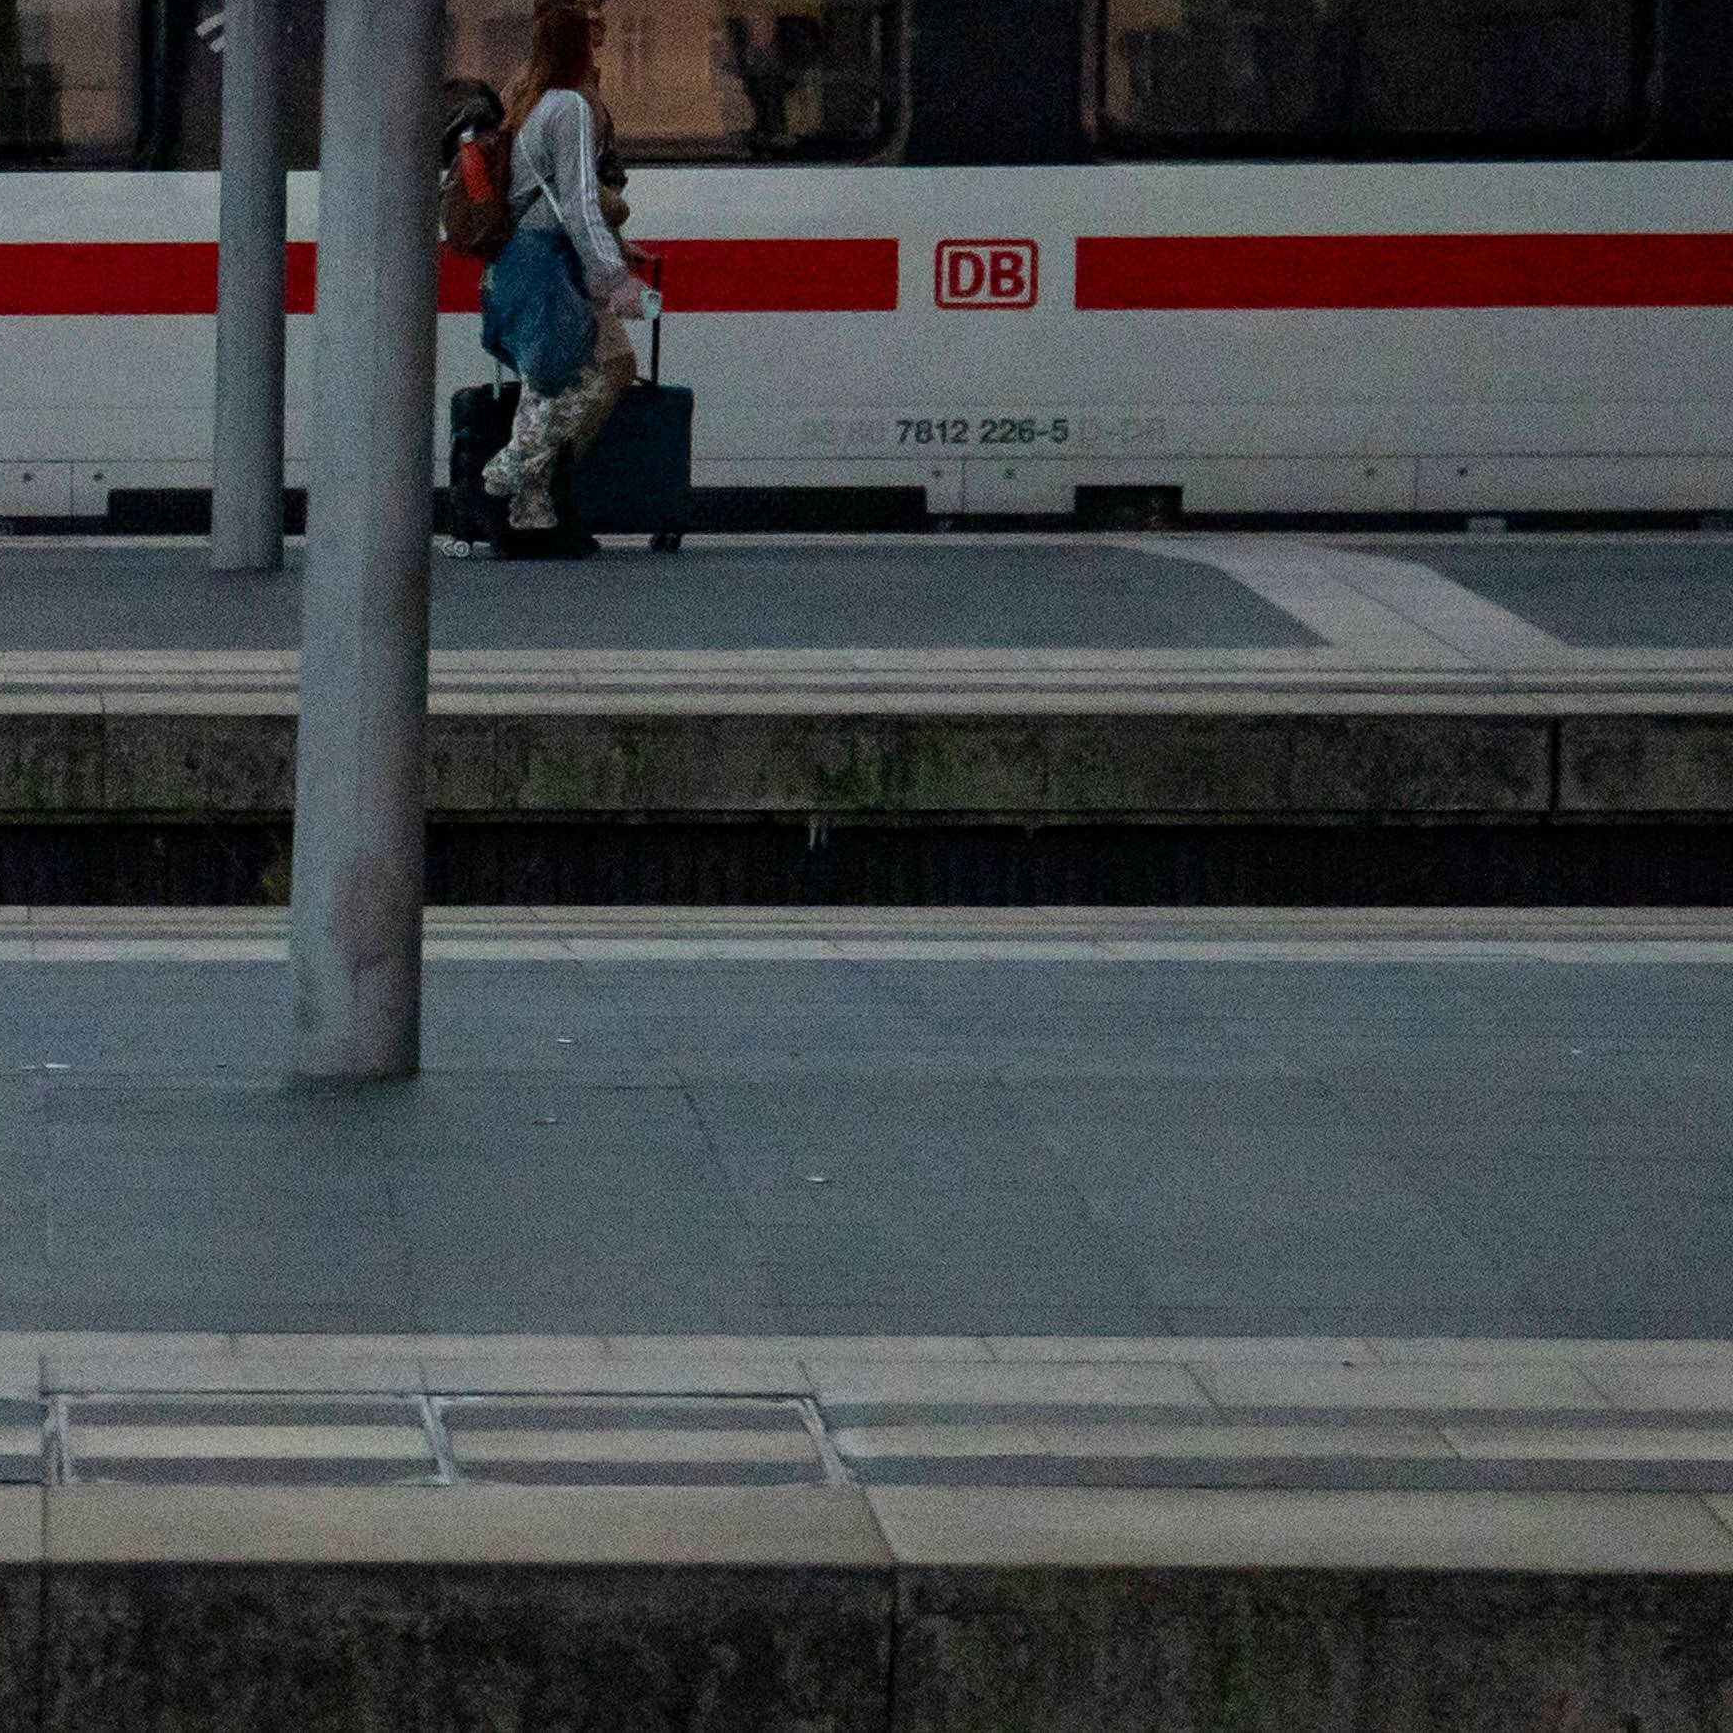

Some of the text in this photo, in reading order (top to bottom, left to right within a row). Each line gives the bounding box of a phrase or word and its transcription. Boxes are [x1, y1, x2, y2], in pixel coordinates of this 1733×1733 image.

[948, 250, 1026, 298] DB
[895, 417, 970, 445] 7812
[978, 417, 1071, 444] 226-5
